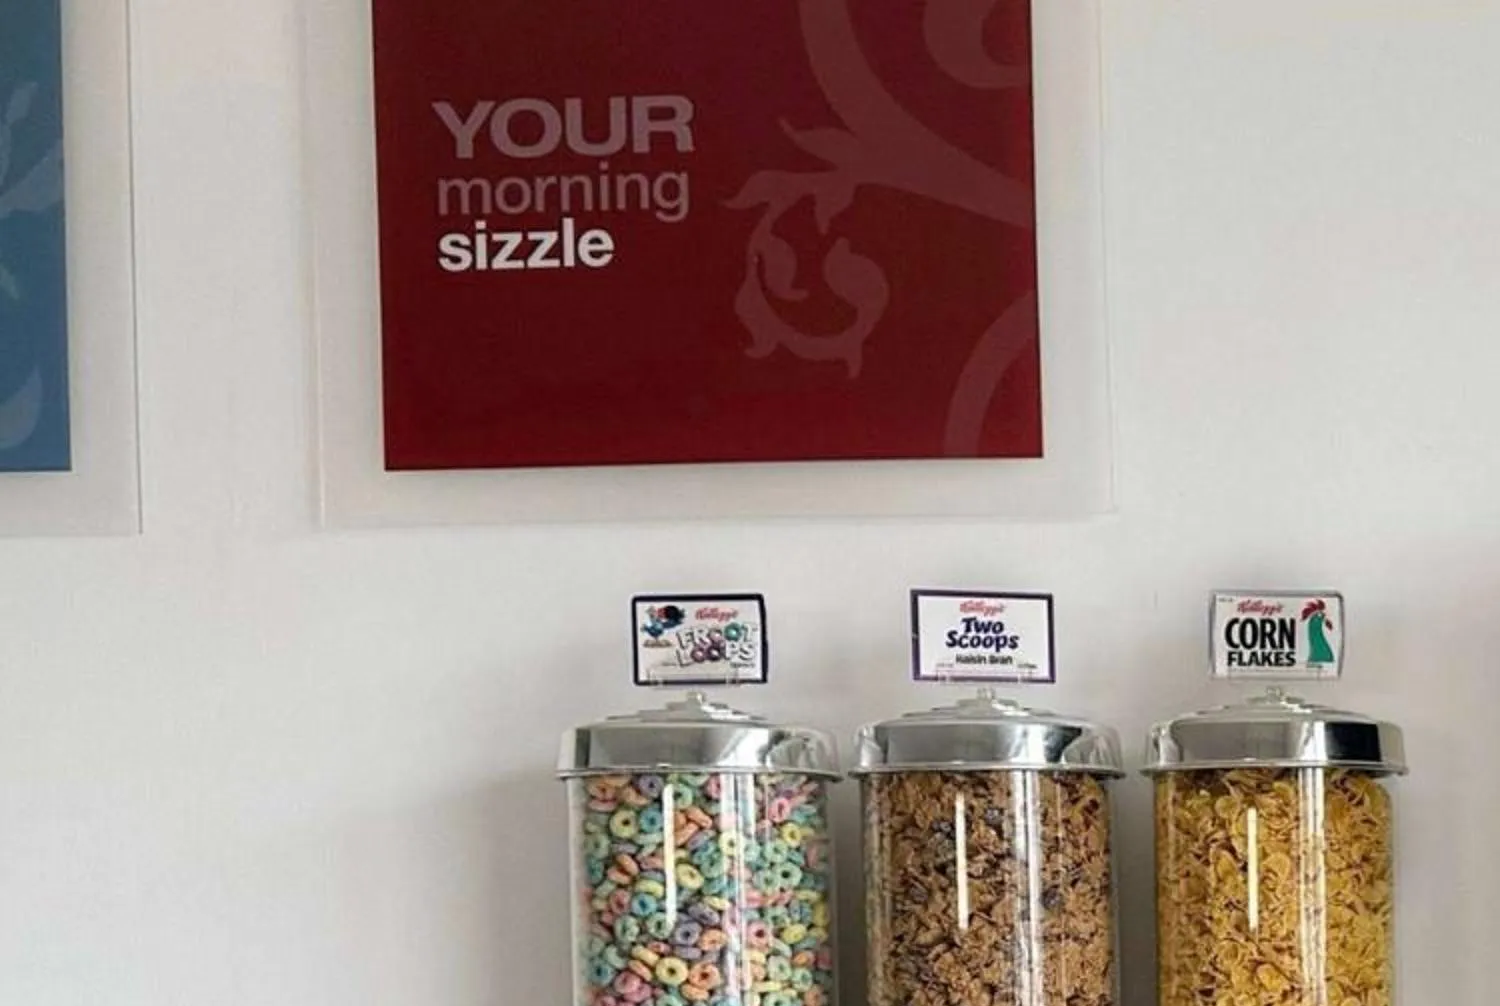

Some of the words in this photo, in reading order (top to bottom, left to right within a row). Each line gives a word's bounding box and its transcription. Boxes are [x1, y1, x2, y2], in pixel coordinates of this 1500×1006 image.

[432, 95, 695, 158] YOUR
[438, 161, 689, 223] morning
[438, 217, 614, 272] sizzle
[960, 616, 1004, 634] Two
[1225, 618, 1296, 649] CORN
[945, 630, 1019, 652] Scoops
[1227, 651, 1297, 667] FLAKES
